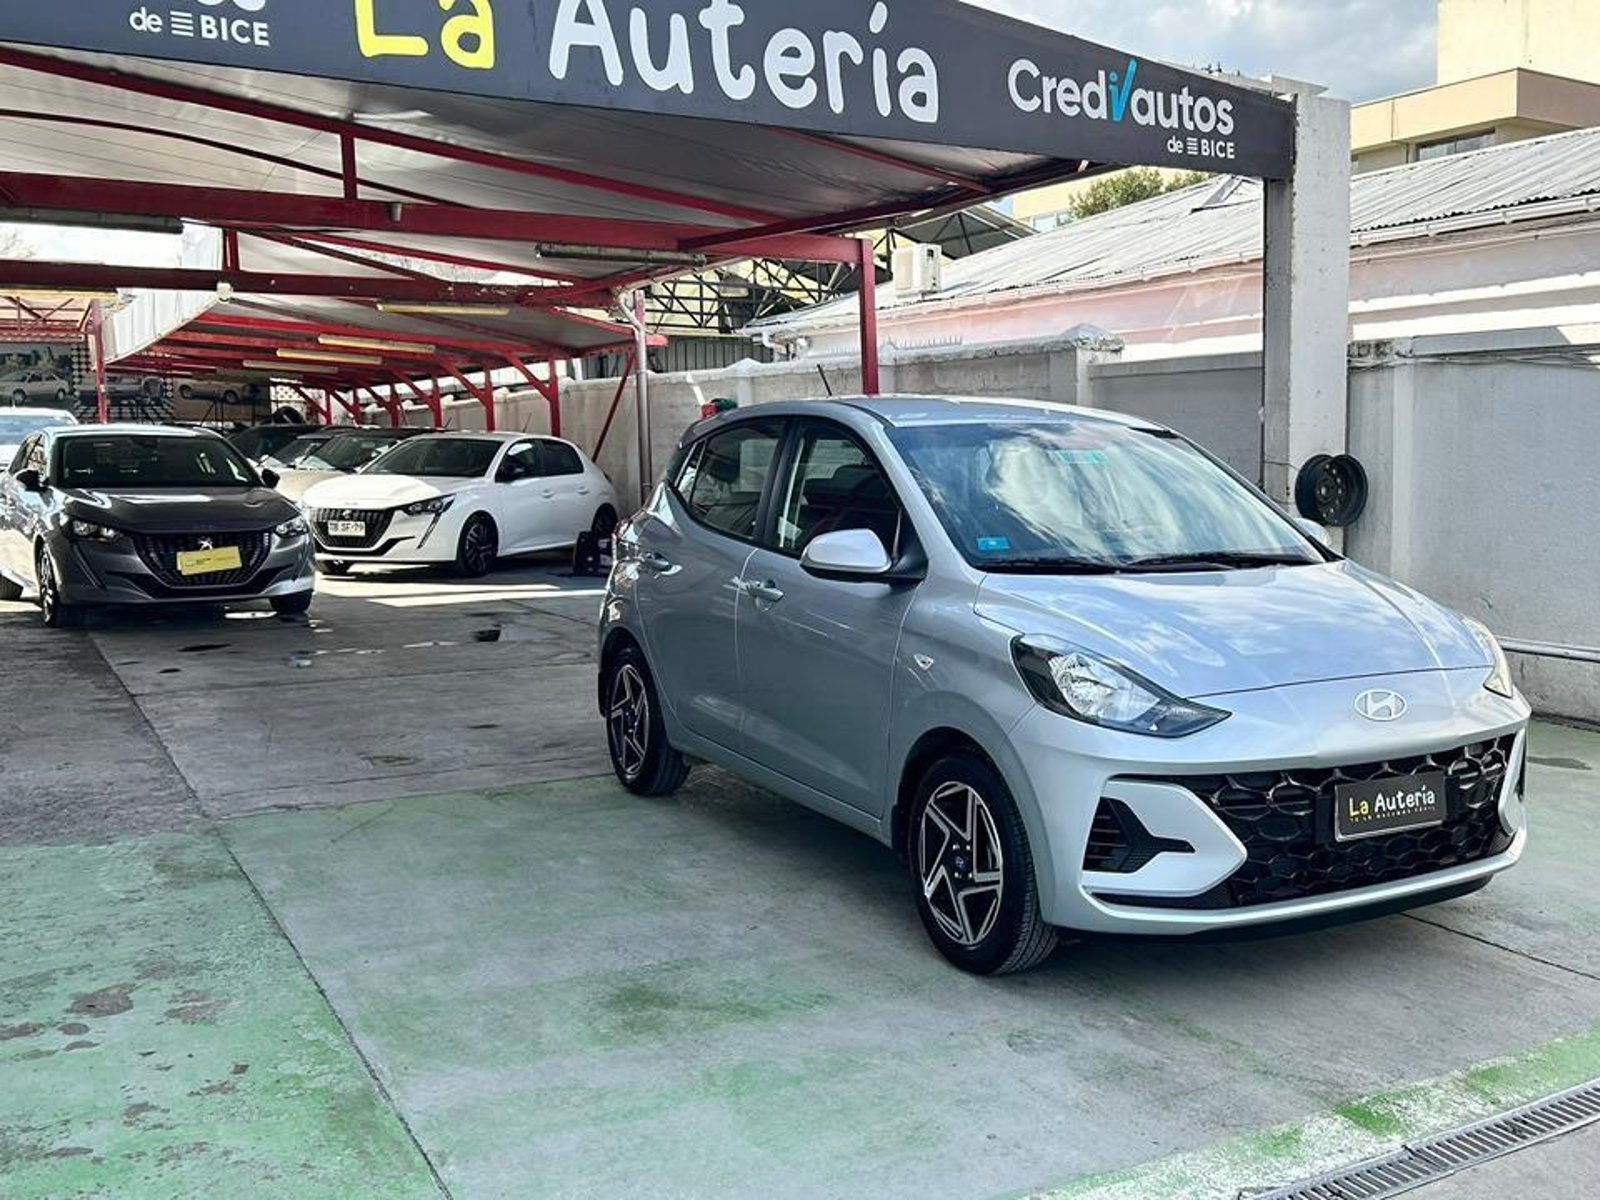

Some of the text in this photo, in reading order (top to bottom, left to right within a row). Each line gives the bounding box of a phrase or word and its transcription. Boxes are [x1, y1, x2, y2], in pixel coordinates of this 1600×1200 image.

[129, 6, 270, 47] de BICE
[355, 0, 939, 123] La Autería
[1167, 136, 1235, 159] de BICE
[1348, 797, 1369, 817] La
[1374, 784, 1436, 813] Autería
